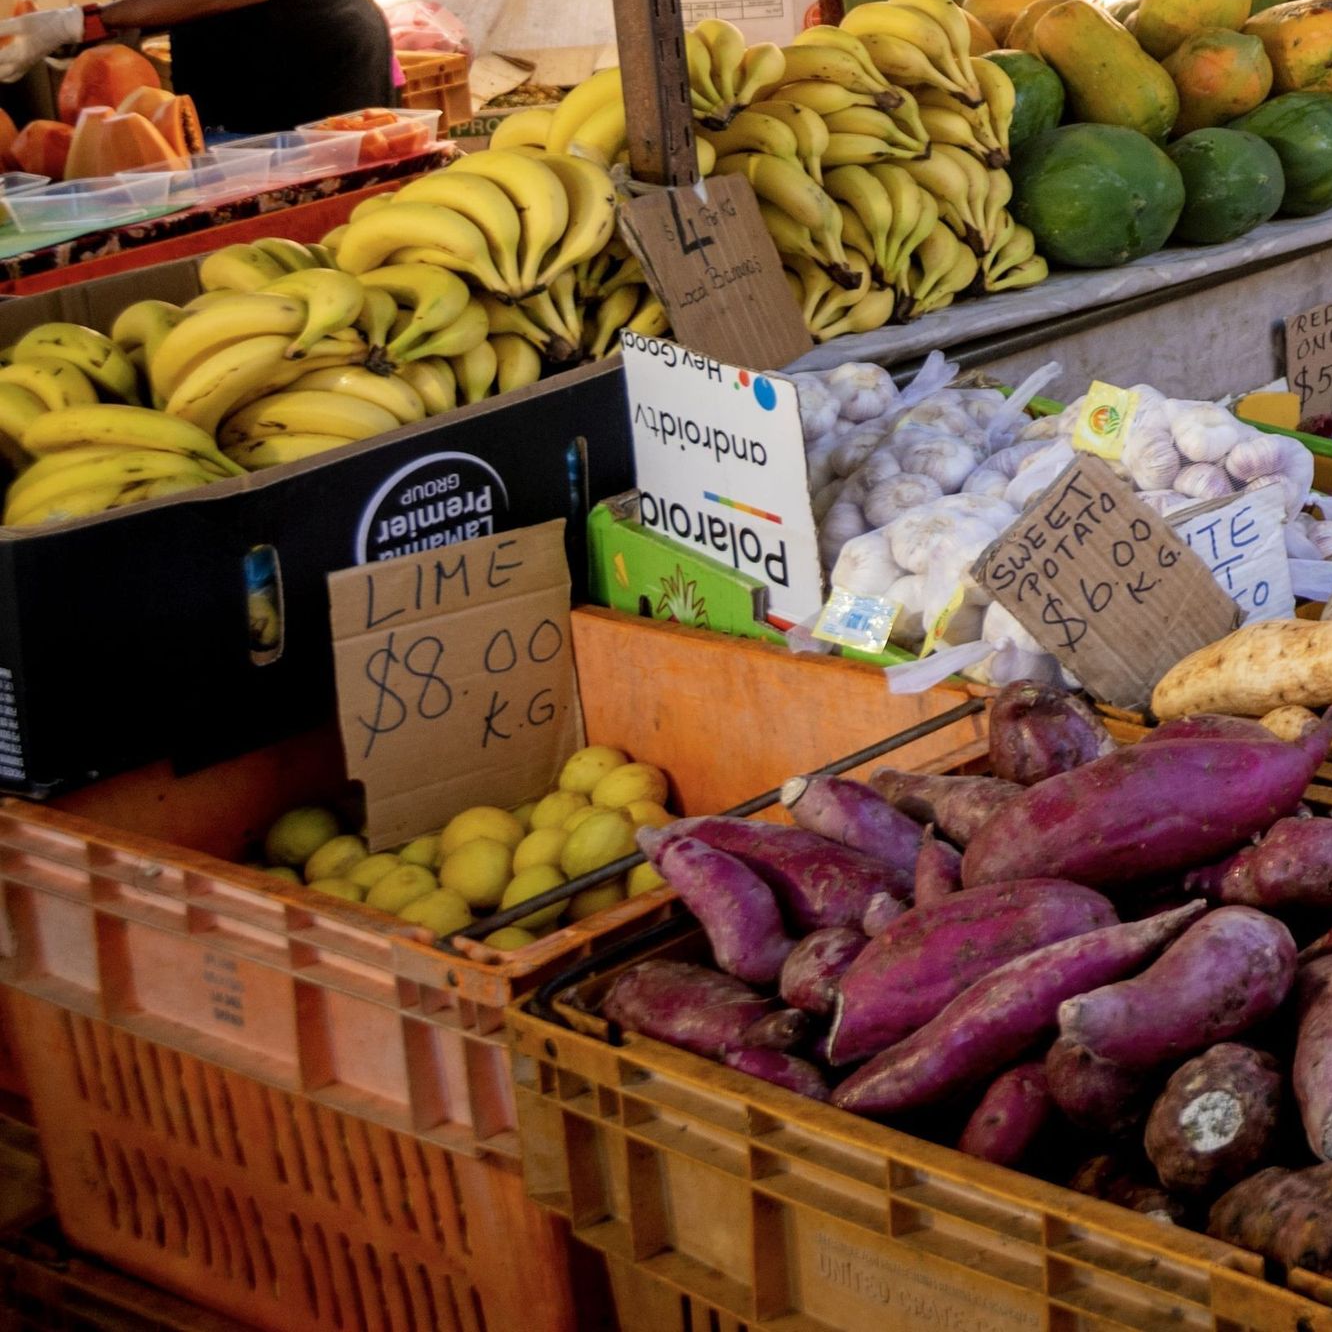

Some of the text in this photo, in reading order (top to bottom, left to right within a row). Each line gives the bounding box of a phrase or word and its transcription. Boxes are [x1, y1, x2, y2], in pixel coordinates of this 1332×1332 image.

[376, 486, 493, 543] Premier
[400, 473, 460, 506] GROUP
[992, 470, 1092, 590] SWEET
[367, 540, 523, 629] LIME
[639, 490, 789, 587] Polaroid
[1017, 493, 1116, 602] POTATO
